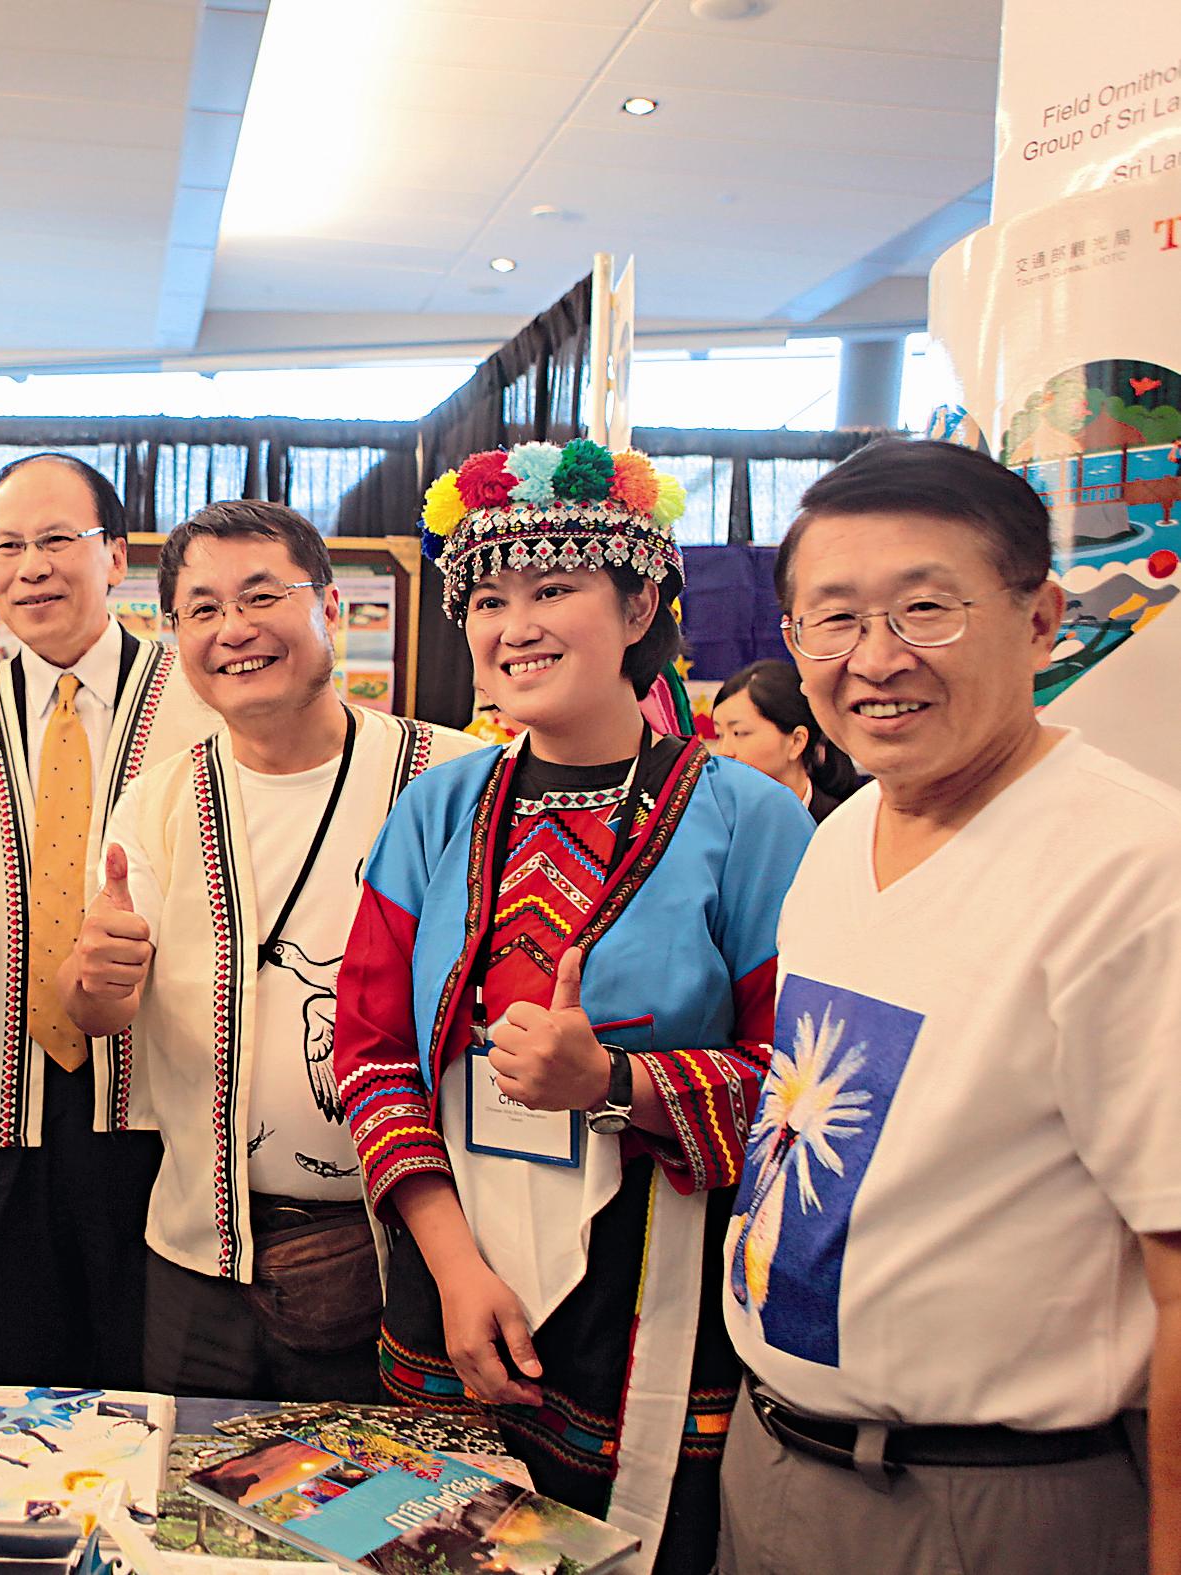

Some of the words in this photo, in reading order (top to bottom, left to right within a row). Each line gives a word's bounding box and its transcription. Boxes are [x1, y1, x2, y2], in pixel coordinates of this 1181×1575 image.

[1042, 92, 1091, 128] Field
[1022, 129, 1084, 161] Group
[1090, 113, 1112, 139] of
[1116, 102, 1146, 130] Sri
[1112, 159, 1142, 183] Sri
